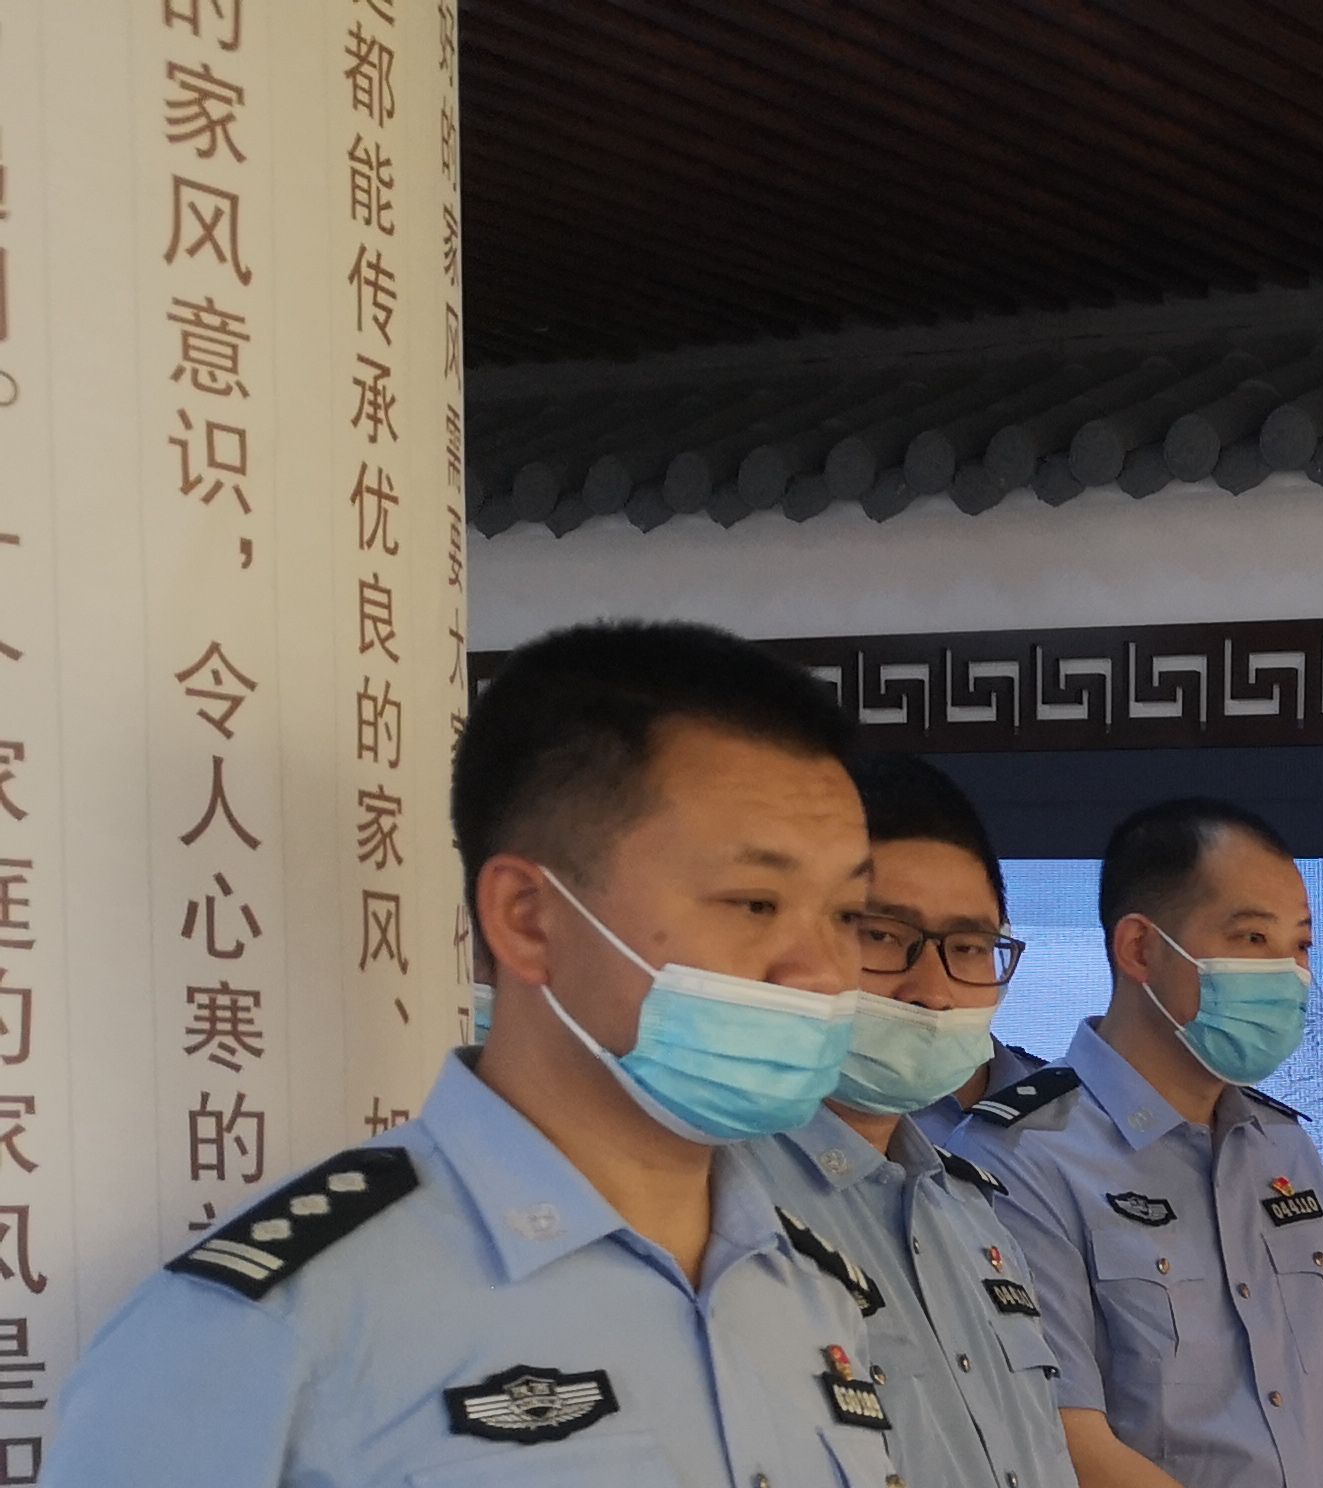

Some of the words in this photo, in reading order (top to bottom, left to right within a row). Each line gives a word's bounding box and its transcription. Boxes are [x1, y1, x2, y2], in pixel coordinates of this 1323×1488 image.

[162, 0, 266, 1231] 的家风意识，令人心寒的
